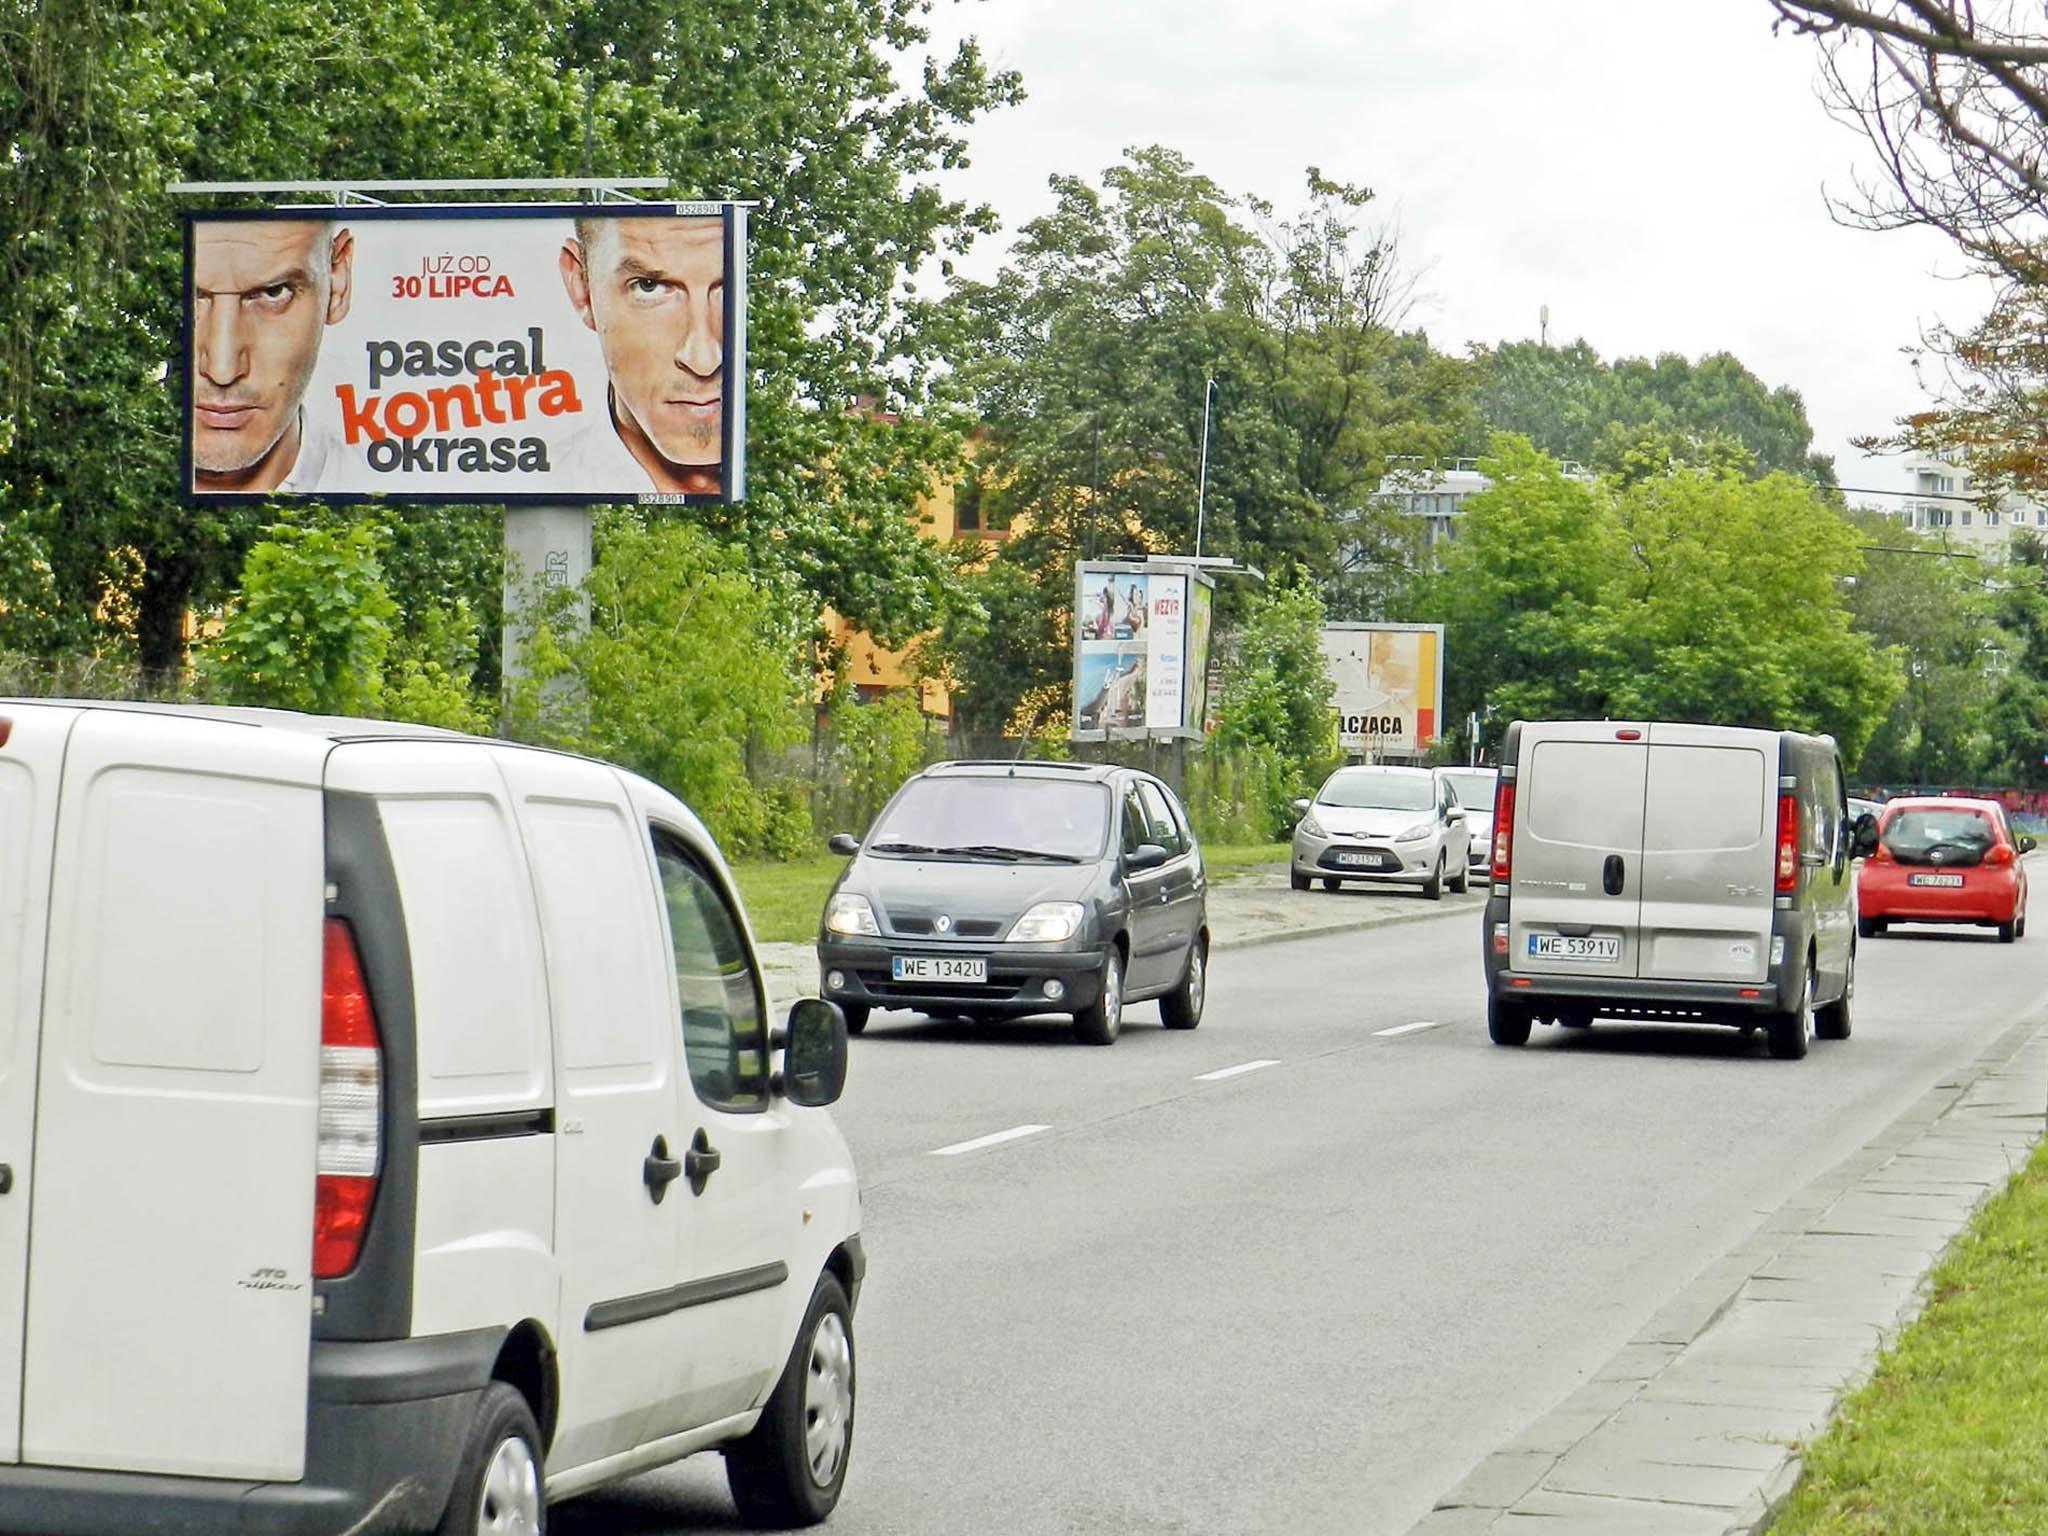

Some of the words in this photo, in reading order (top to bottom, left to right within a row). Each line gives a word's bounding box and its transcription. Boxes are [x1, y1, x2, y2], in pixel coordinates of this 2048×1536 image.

[421, 251, 454, 279] JUŻ
[458, 255, 491, 273] OD
[392, 275, 422, 298] 30
[429, 274, 515, 298] LIPCA
[366, 327, 547, 390] pascal
[335, 368, 583, 445] kontra
[367, 437, 551, 473] okrasa
[1540, 938, 1561, 953] WE
[1567, 939, 1616, 956] 5391V
[904, 960, 928, 976] WE
[935, 961, 983, 977] 1342U
